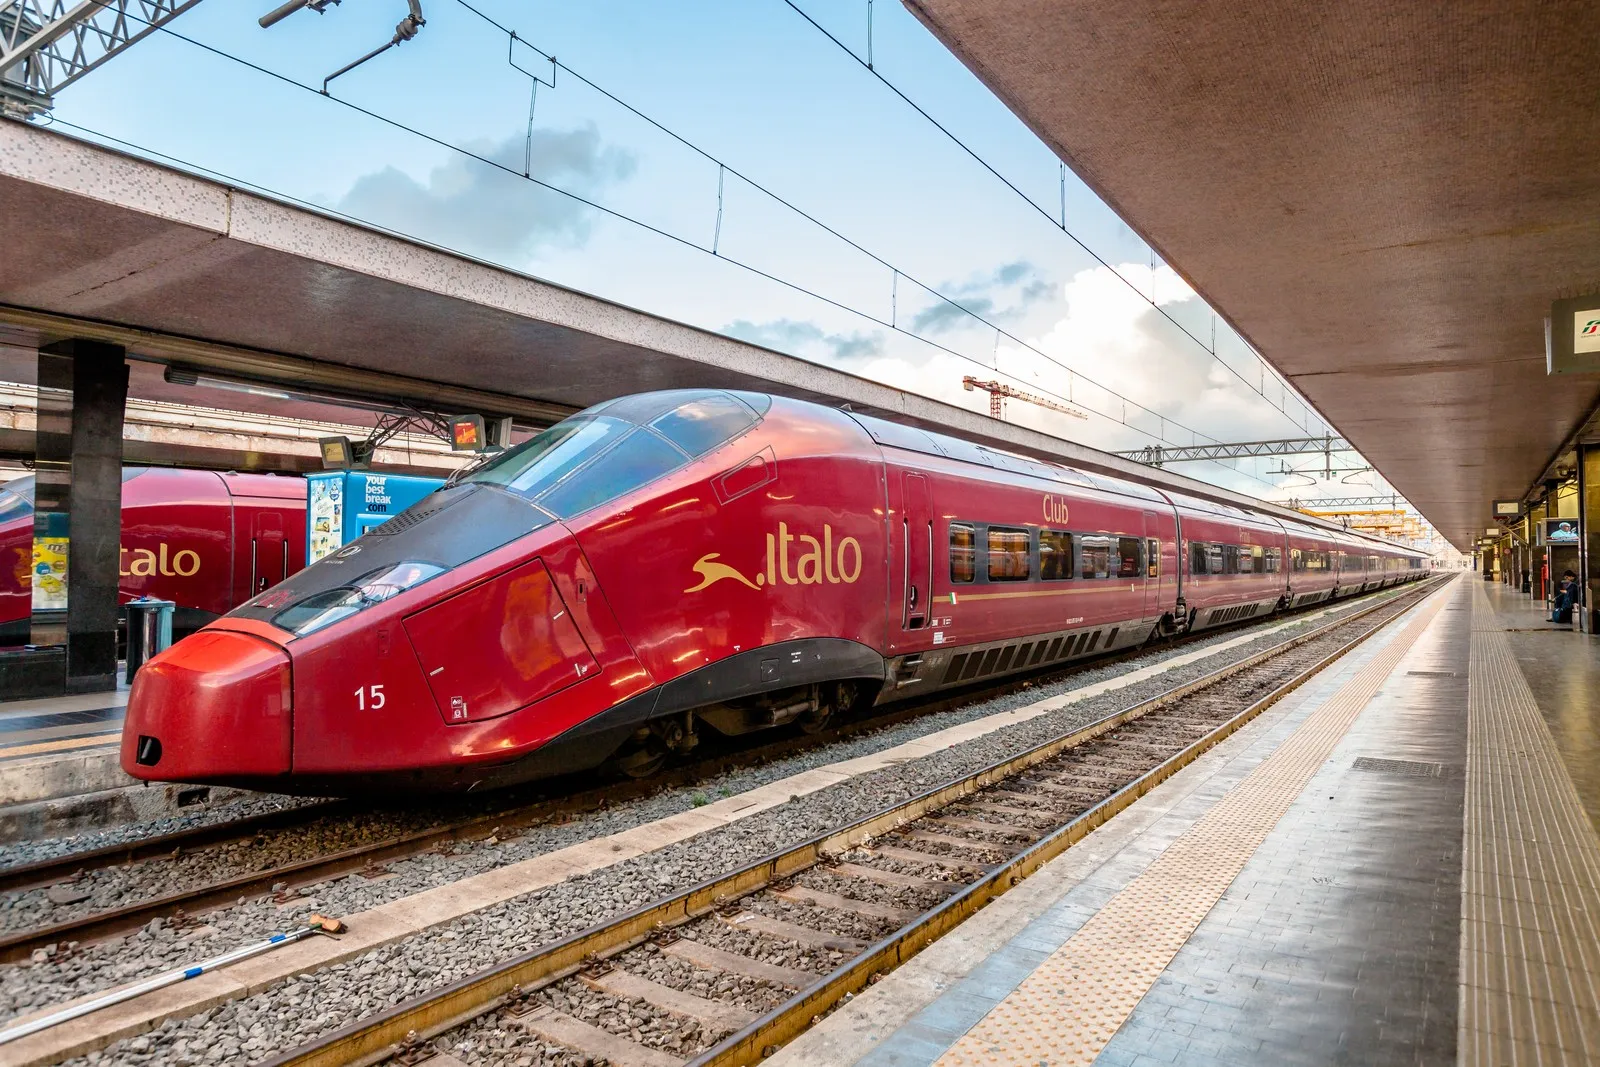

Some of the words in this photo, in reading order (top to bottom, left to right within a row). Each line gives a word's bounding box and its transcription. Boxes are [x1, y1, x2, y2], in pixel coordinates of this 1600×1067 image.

[365, 475, 387, 485] your
[365, 485, 385, 494] best
[365, 494, 391, 504] break
[365, 503, 387, 512] .com
[1043, 494, 1069, 525] Club
[119, 542, 201, 577] talo
[354, 684, 386, 711] 15
